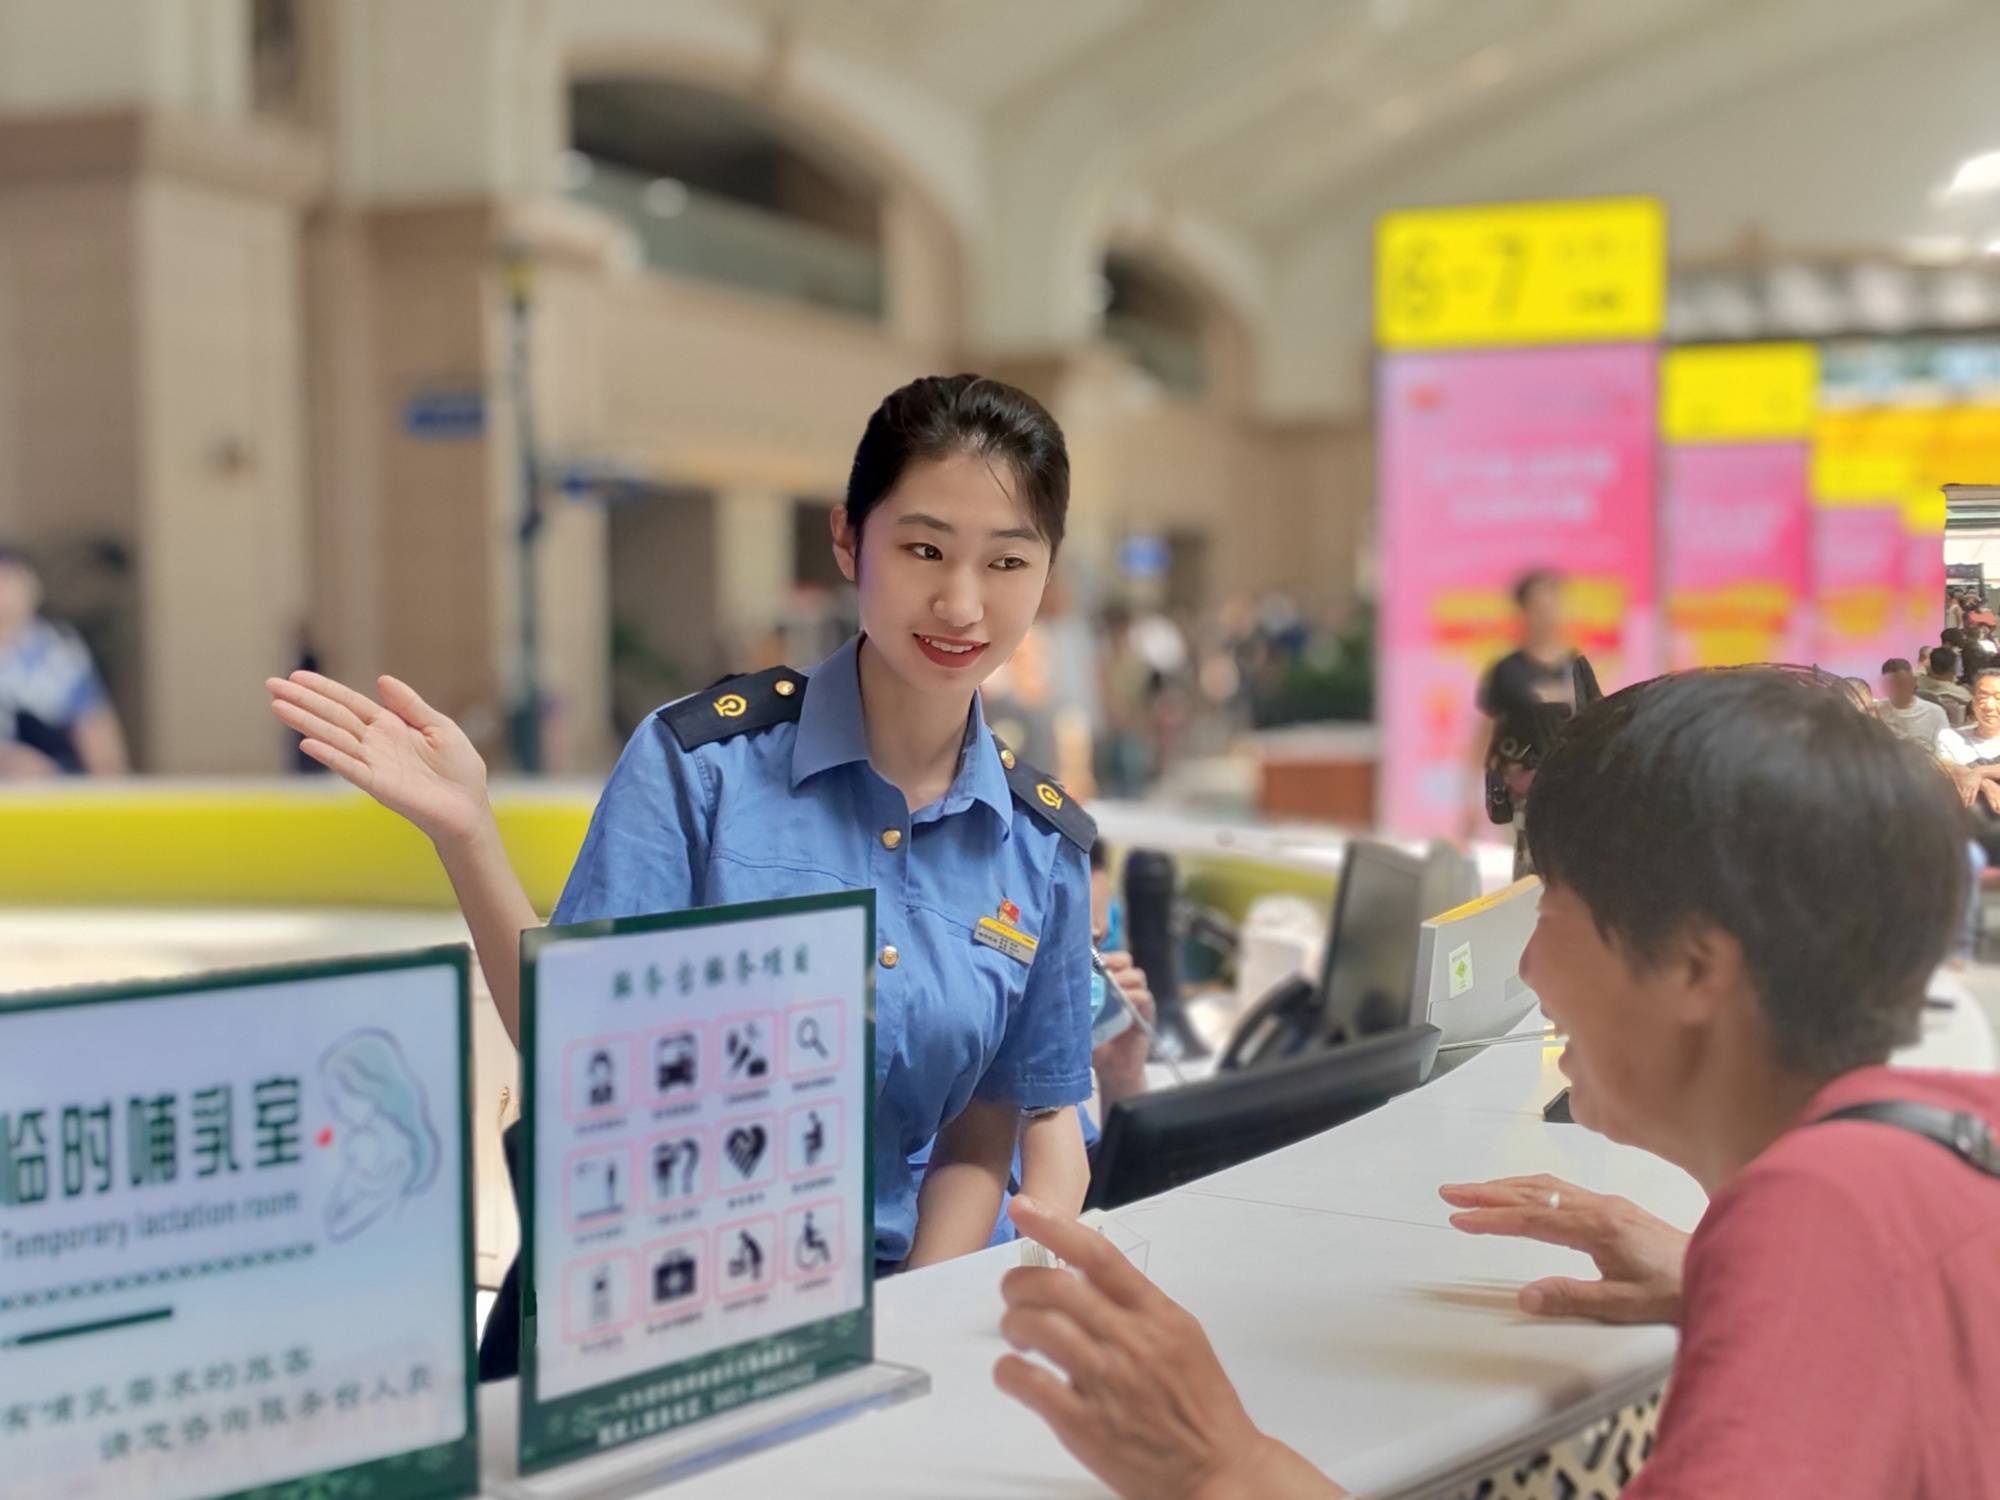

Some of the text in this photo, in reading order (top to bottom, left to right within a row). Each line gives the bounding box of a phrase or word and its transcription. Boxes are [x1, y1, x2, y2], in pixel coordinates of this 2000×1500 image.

[0, 1075, 302, 1206] 临时哺乳室
[134, 1202, 236, 1238] lactation
[244, 1190, 298, 1217] room
